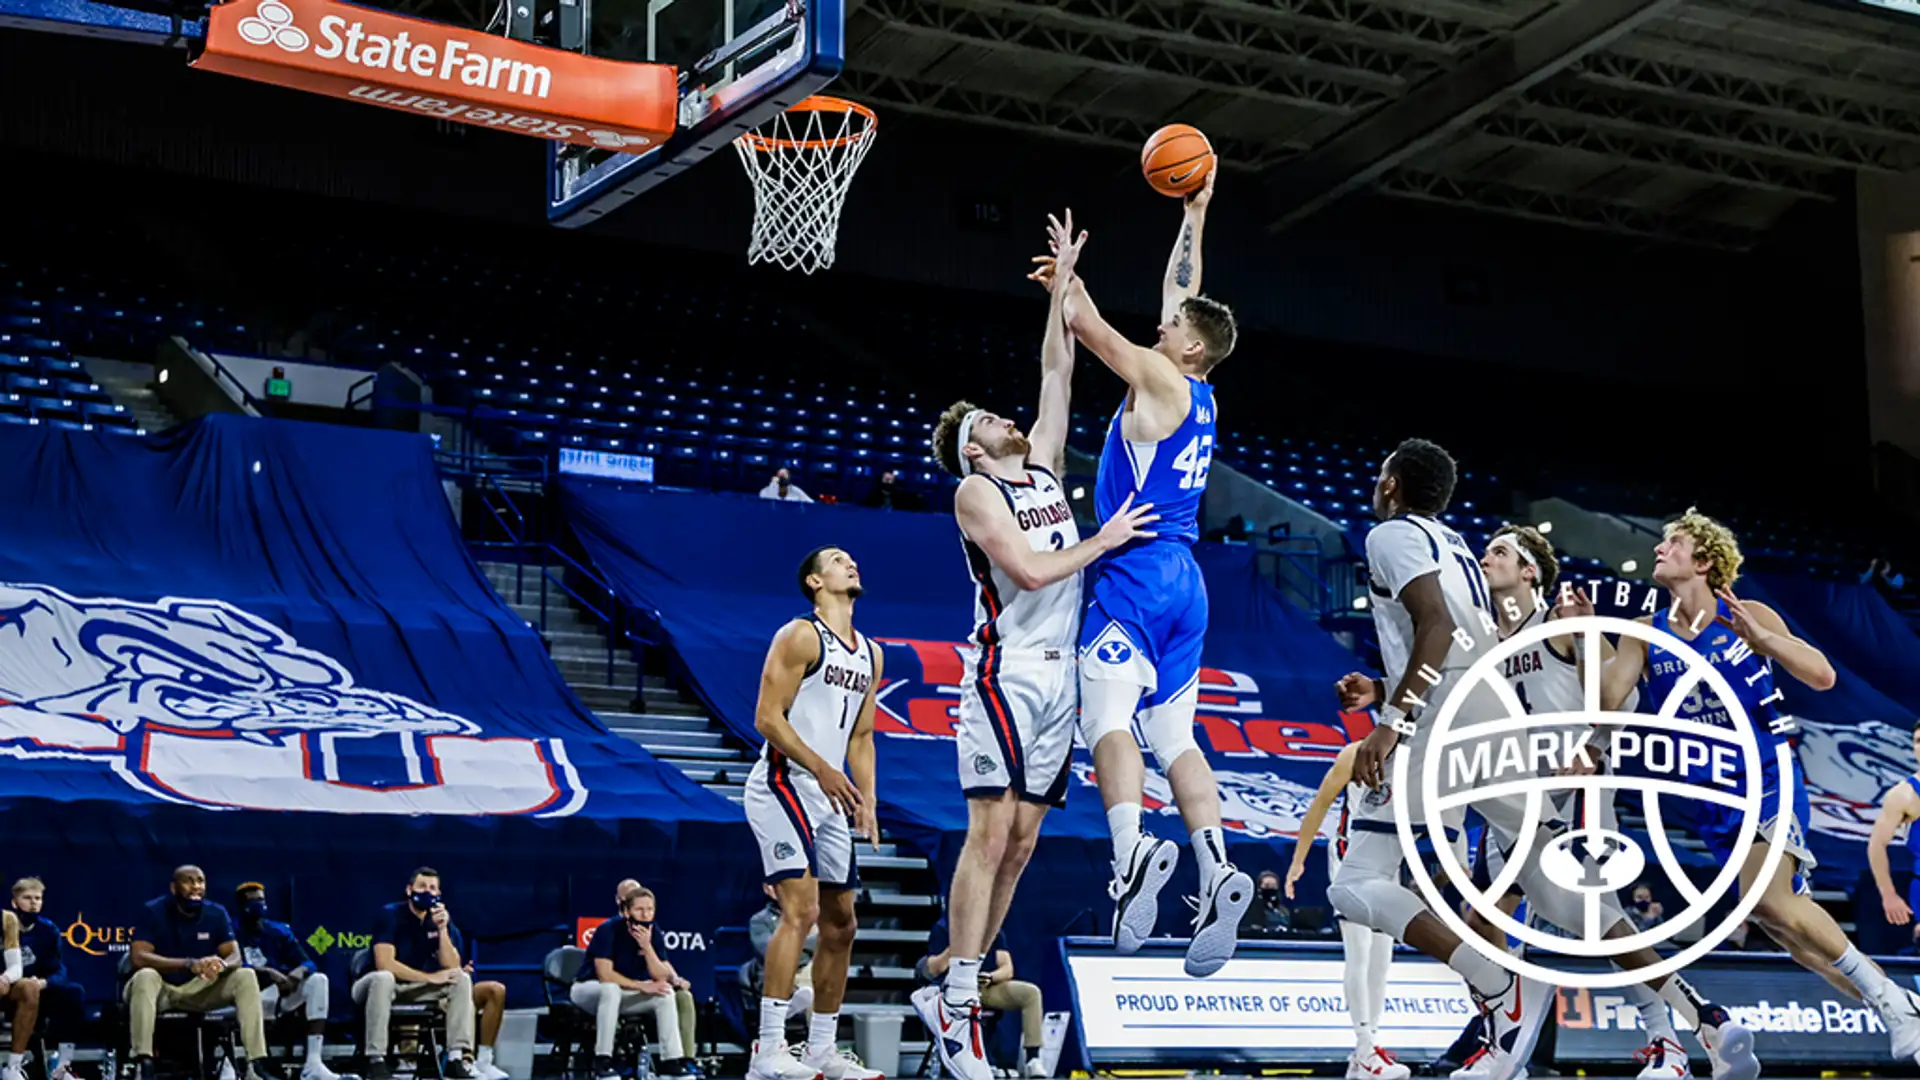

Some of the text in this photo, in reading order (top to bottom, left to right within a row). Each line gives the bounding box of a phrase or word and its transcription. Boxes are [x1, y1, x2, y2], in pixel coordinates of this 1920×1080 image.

[1171, 435, 1213, 489] 42
[1452, 551, 1490, 610] 11
[1504, 650, 1543, 678] ZAGA
[839, 695, 849, 729] 1
[660, 931, 706, 951] OTA
[1115, 994, 1469, 1015] PROUD PARTNER OF GONZ ATHLETICS
[1821, 1000, 1888, 1034] Bank
